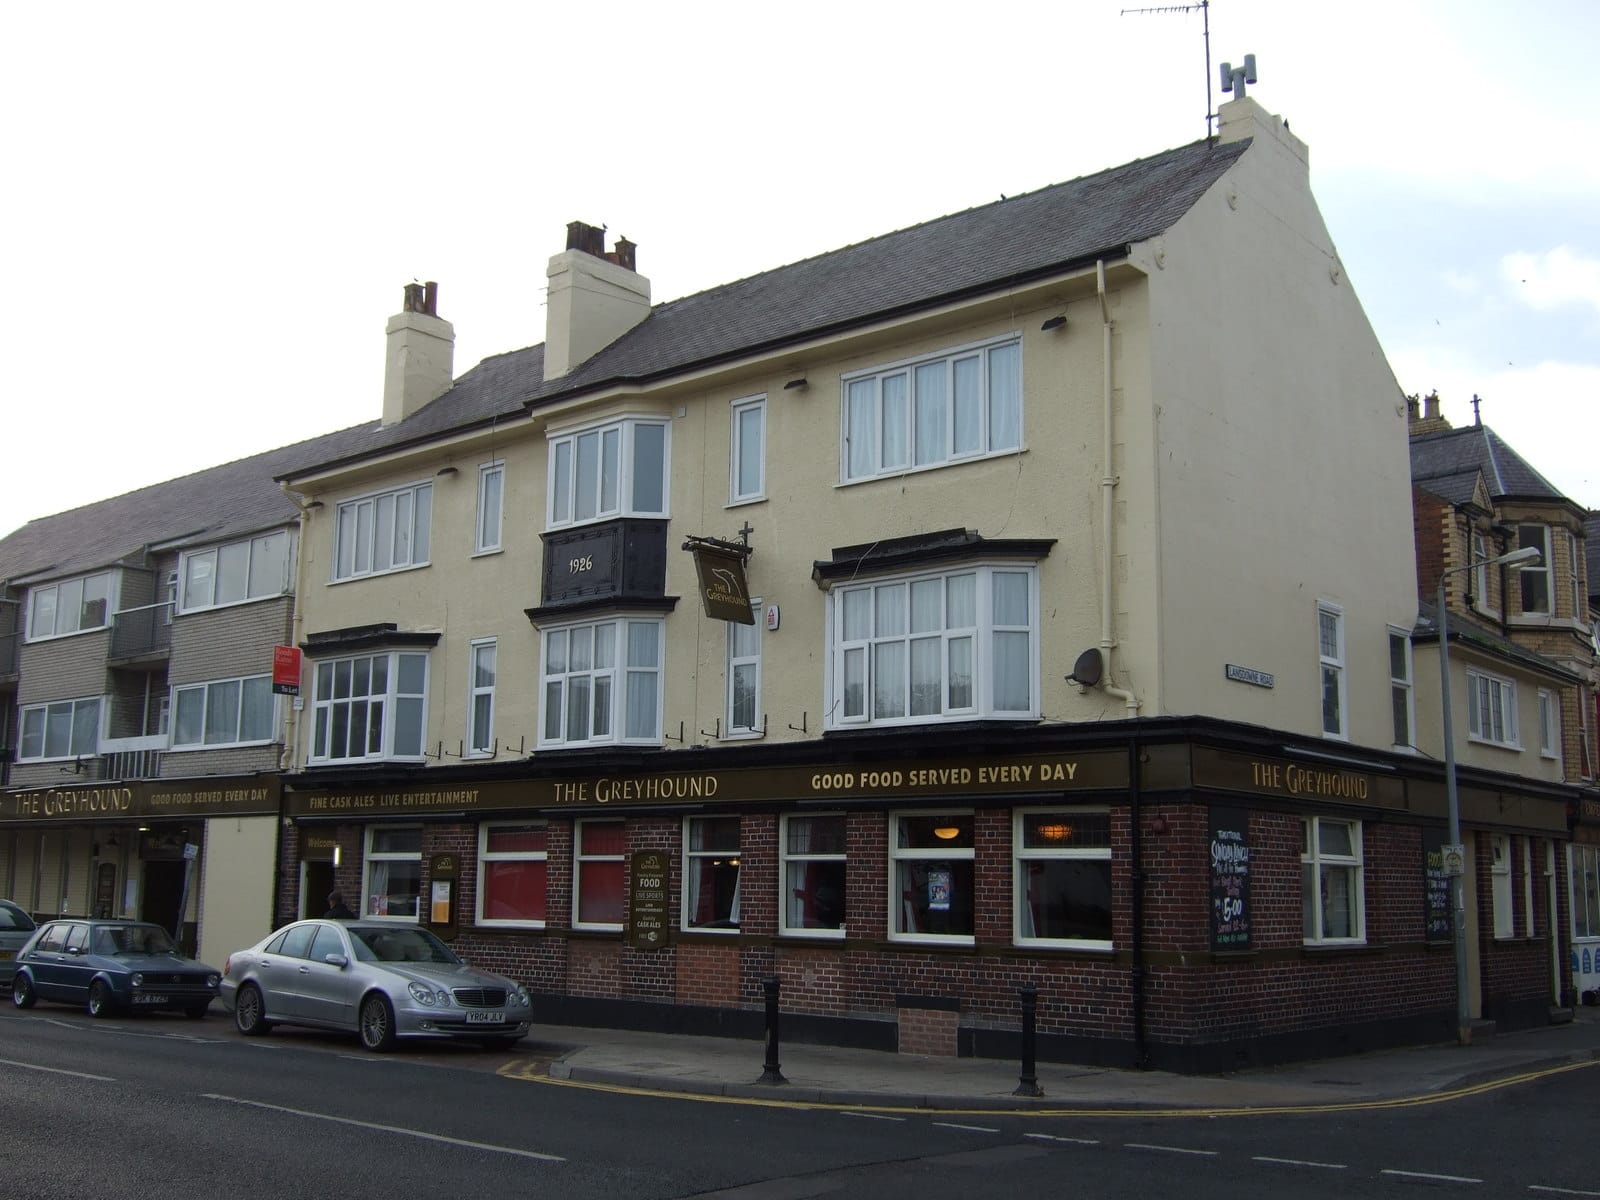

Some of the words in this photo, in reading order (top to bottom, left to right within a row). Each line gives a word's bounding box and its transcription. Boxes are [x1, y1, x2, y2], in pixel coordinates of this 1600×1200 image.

[568, 554, 593, 575] 1926
[811, 773, 854, 789] GOOD
[860, 771, 902, 788] FOOD
[909, 768, 971, 786] SERVED
[978, 765, 1033, 783] EVERY
[1040, 763, 1077, 781] DAY
[1251, 762, 1281, 788] THE
[1286, 764, 1368, 799] GREYHOUND
[150, 793, 171, 805] GOOD
[172, 792, 192, 804] FOOD
[194, 791, 222, 803] SERVED
[225, 789, 249, 802] EVERY
[251, 788, 268, 801] DAY
[310, 797, 328, 809] FINE
[330, 796, 351, 808] CASK
[354, 795, 375, 807] ALES
[380, 794, 400, 806] LIVE
[402, 790, 480, 806] ENTERTAINMENT
[554, 782, 588, 802] THE
[596, 776, 718, 803] GREYHOUND
[15, 793, 40, 815] THE
[45, 788, 131, 816] GREYHOUND
[639, 878, 660, 888] FOOD
